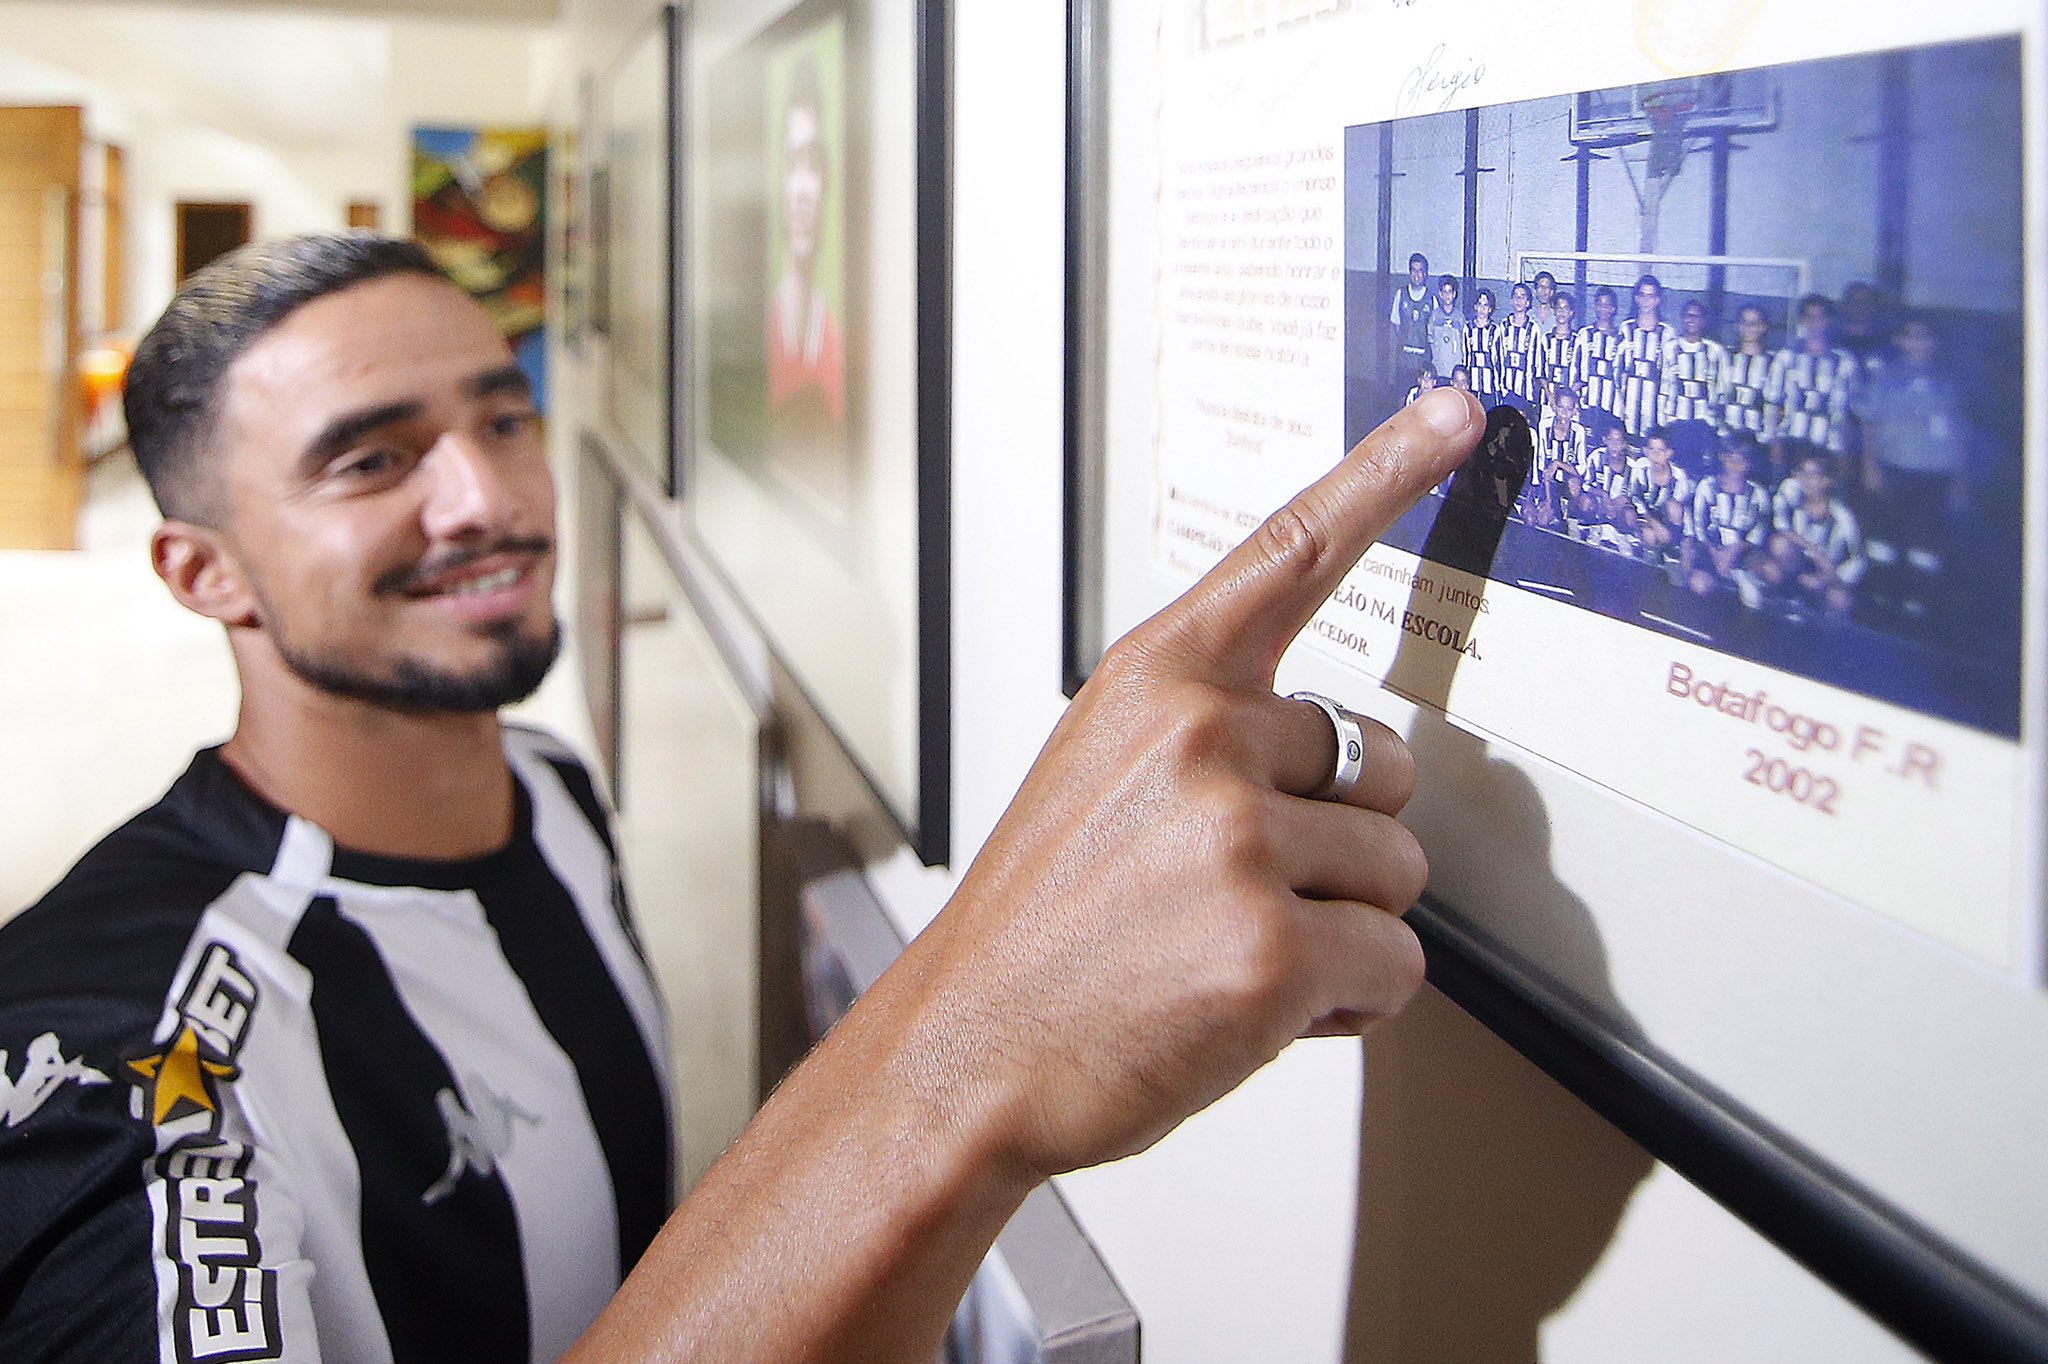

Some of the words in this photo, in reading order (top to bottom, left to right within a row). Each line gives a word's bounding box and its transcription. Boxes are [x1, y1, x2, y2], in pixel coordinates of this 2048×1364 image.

[1362, 556, 1434, 595] caminham
[1370, 597, 1396, 626] NA
[1666, 661, 1840, 751] Botafogo
[1743, 748, 1840, 815] 2002
